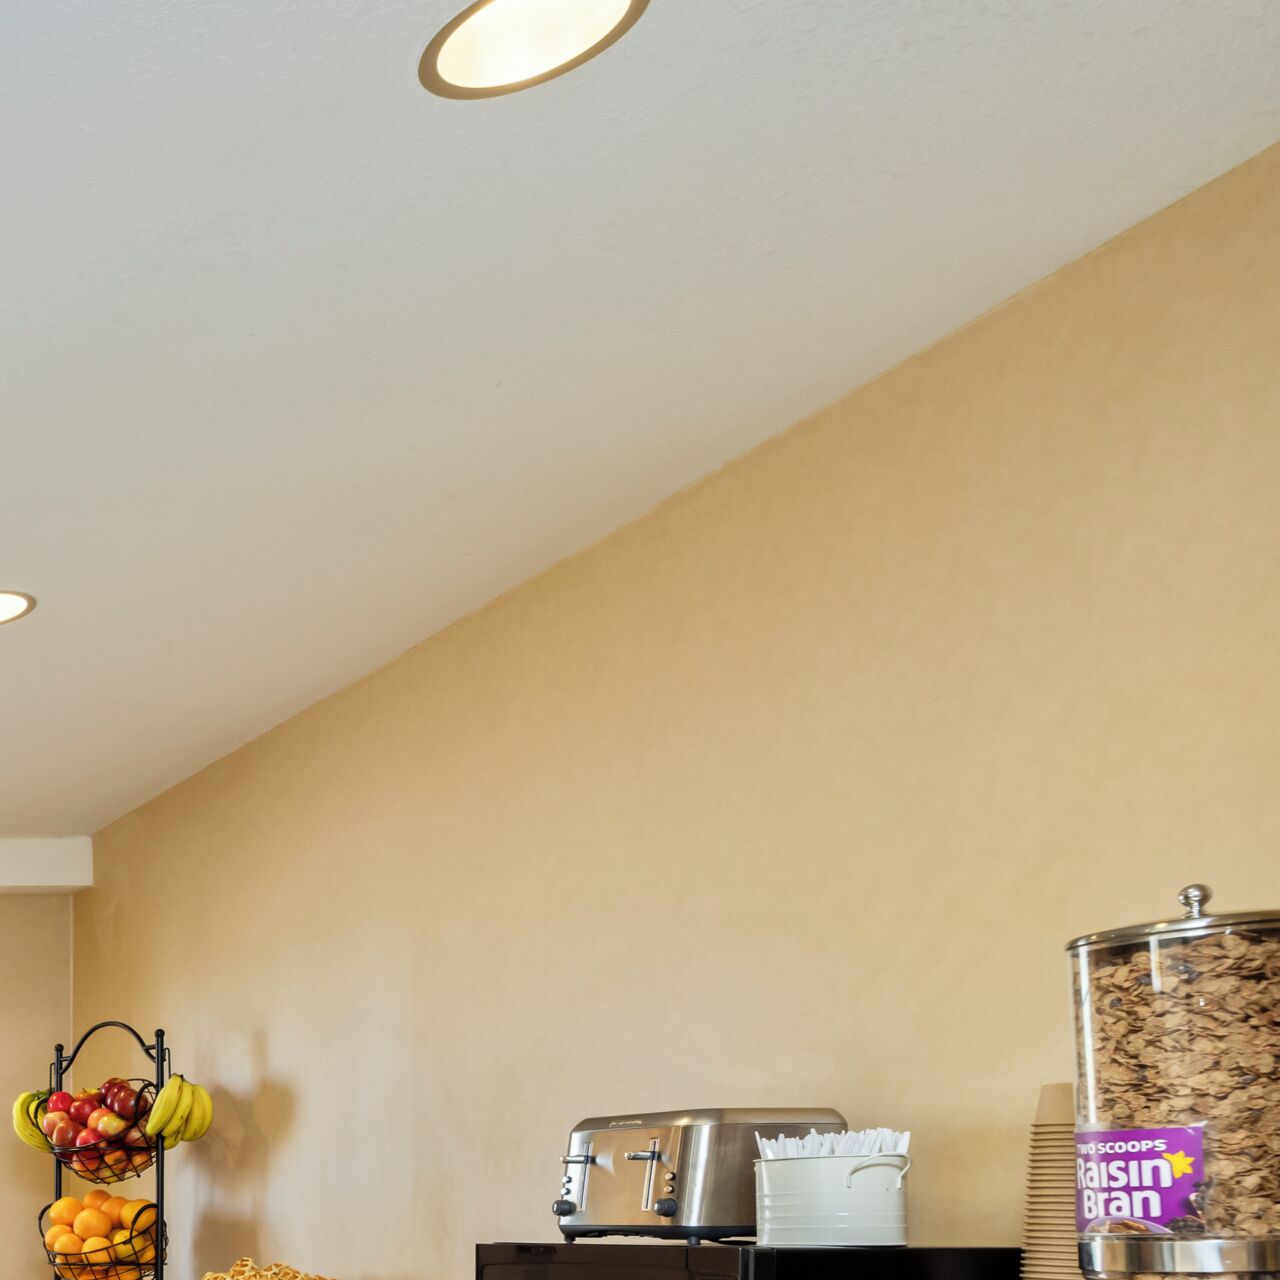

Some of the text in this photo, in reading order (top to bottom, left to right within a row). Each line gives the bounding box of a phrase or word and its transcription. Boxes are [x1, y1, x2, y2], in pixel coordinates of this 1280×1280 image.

[1077, 1139, 1168, 1154] TWO SCOOPS
[1076, 1158, 1173, 1189] Raisin
[1083, 1189, 1162, 1220] Bran
